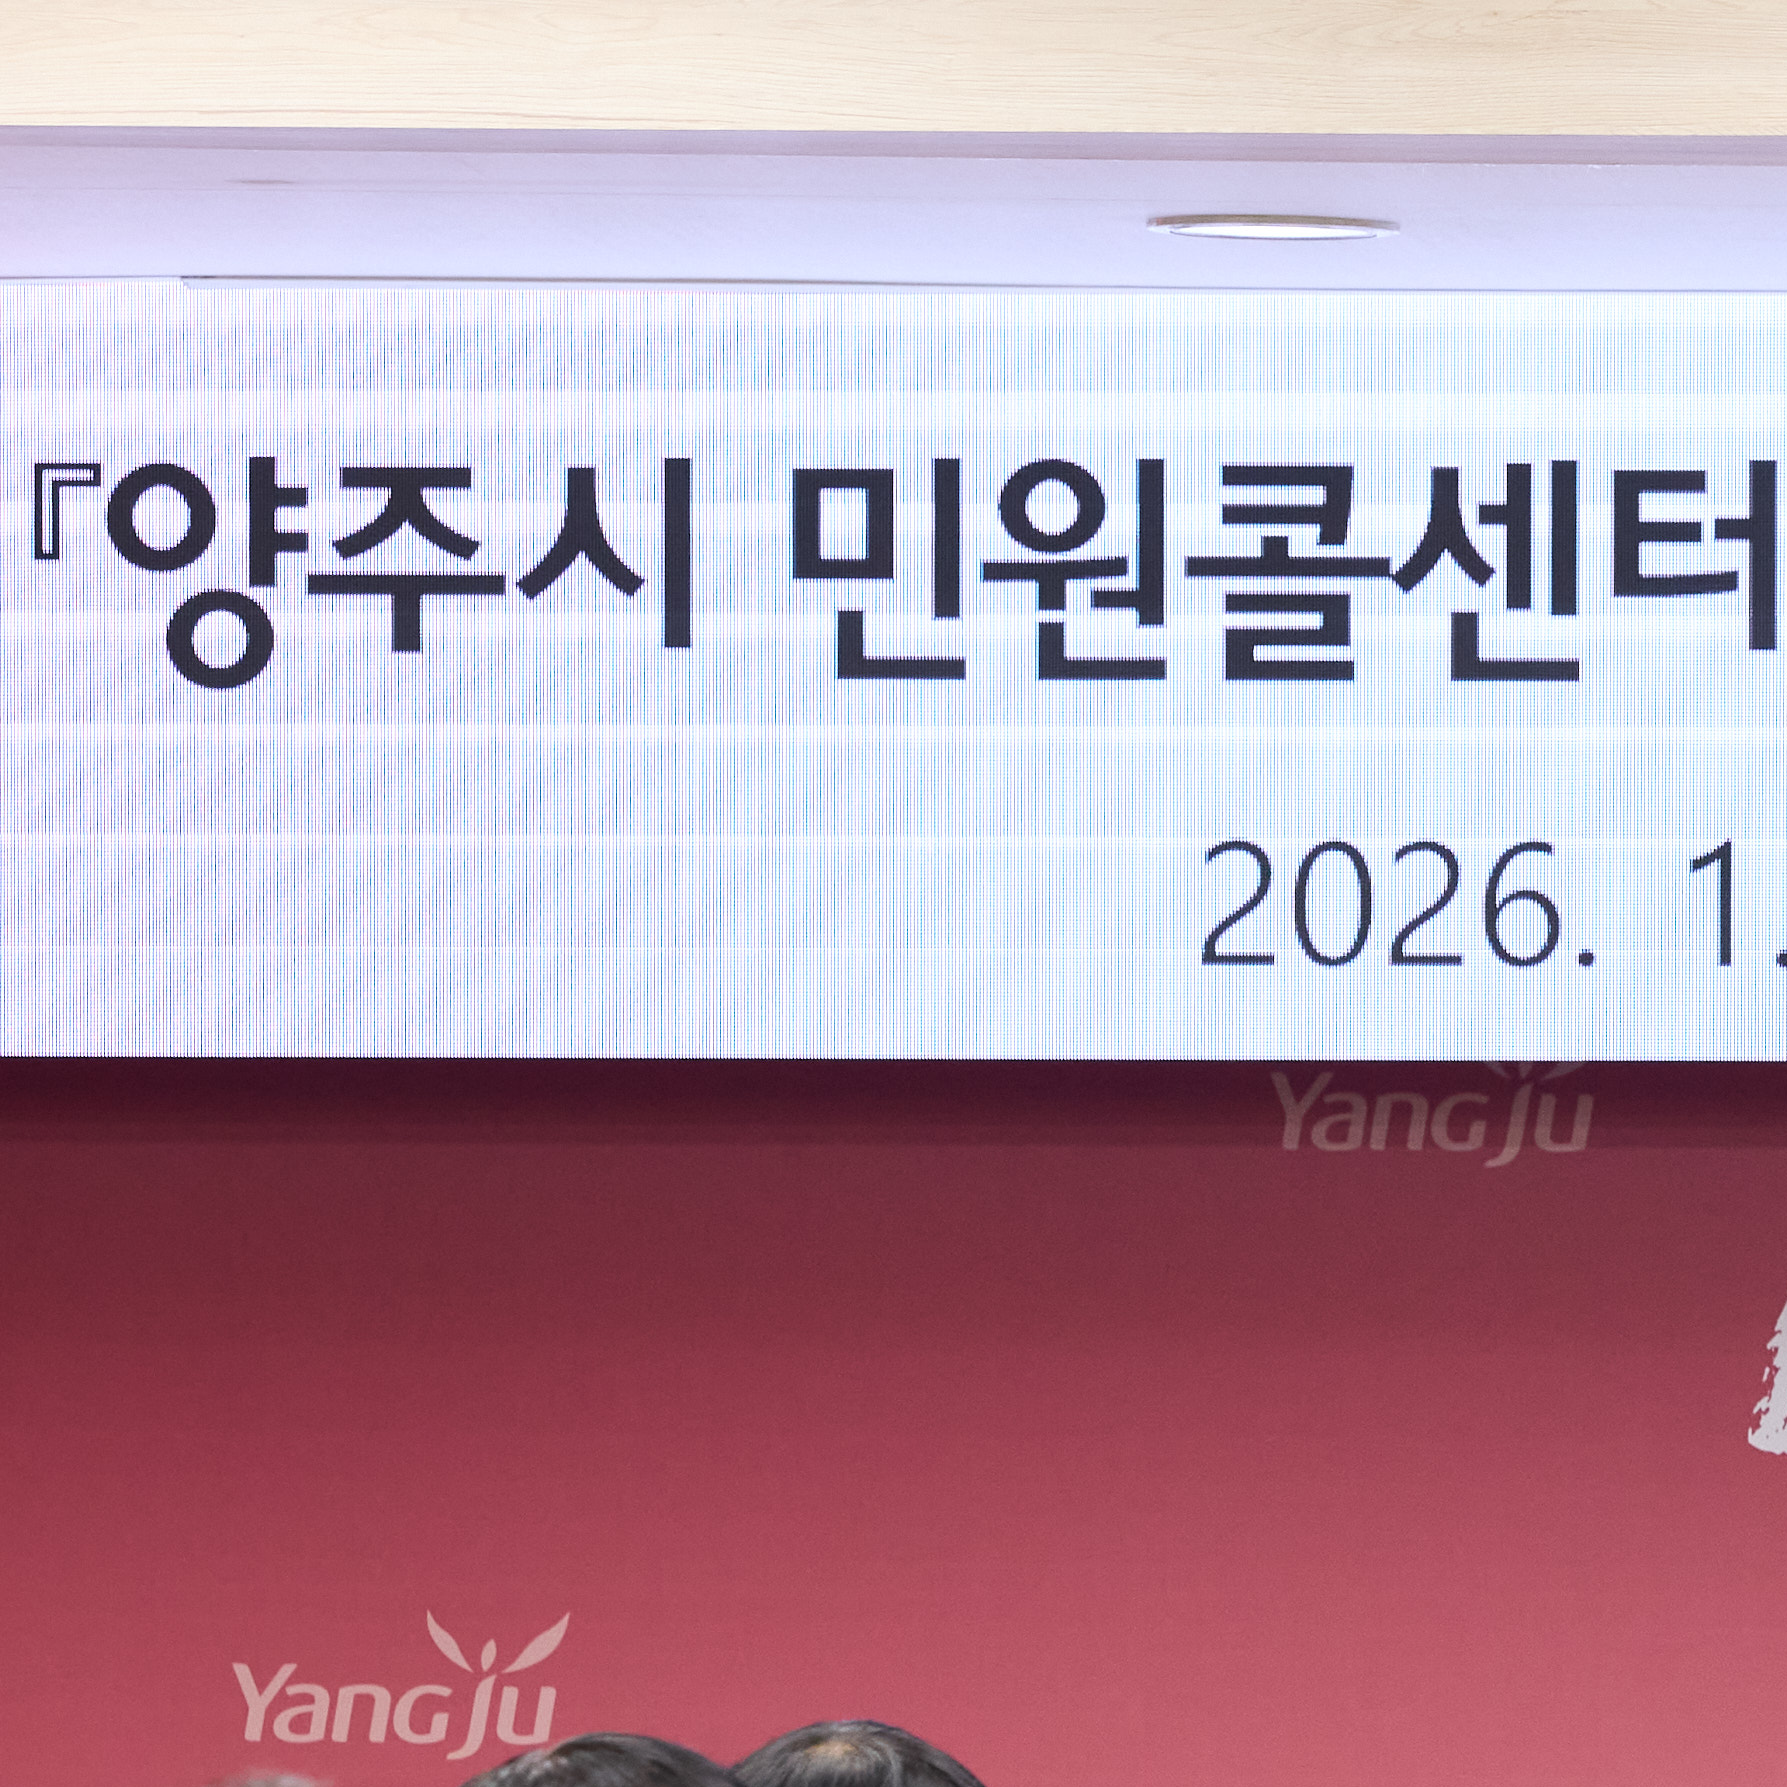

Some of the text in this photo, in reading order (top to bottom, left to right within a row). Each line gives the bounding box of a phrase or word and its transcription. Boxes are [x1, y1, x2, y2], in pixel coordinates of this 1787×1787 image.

[32, 455, 692, 691] 『양주시
[791, 457, 1778, 682] 민원콜센터
[1200, 839, 1594, 968] 2026.
